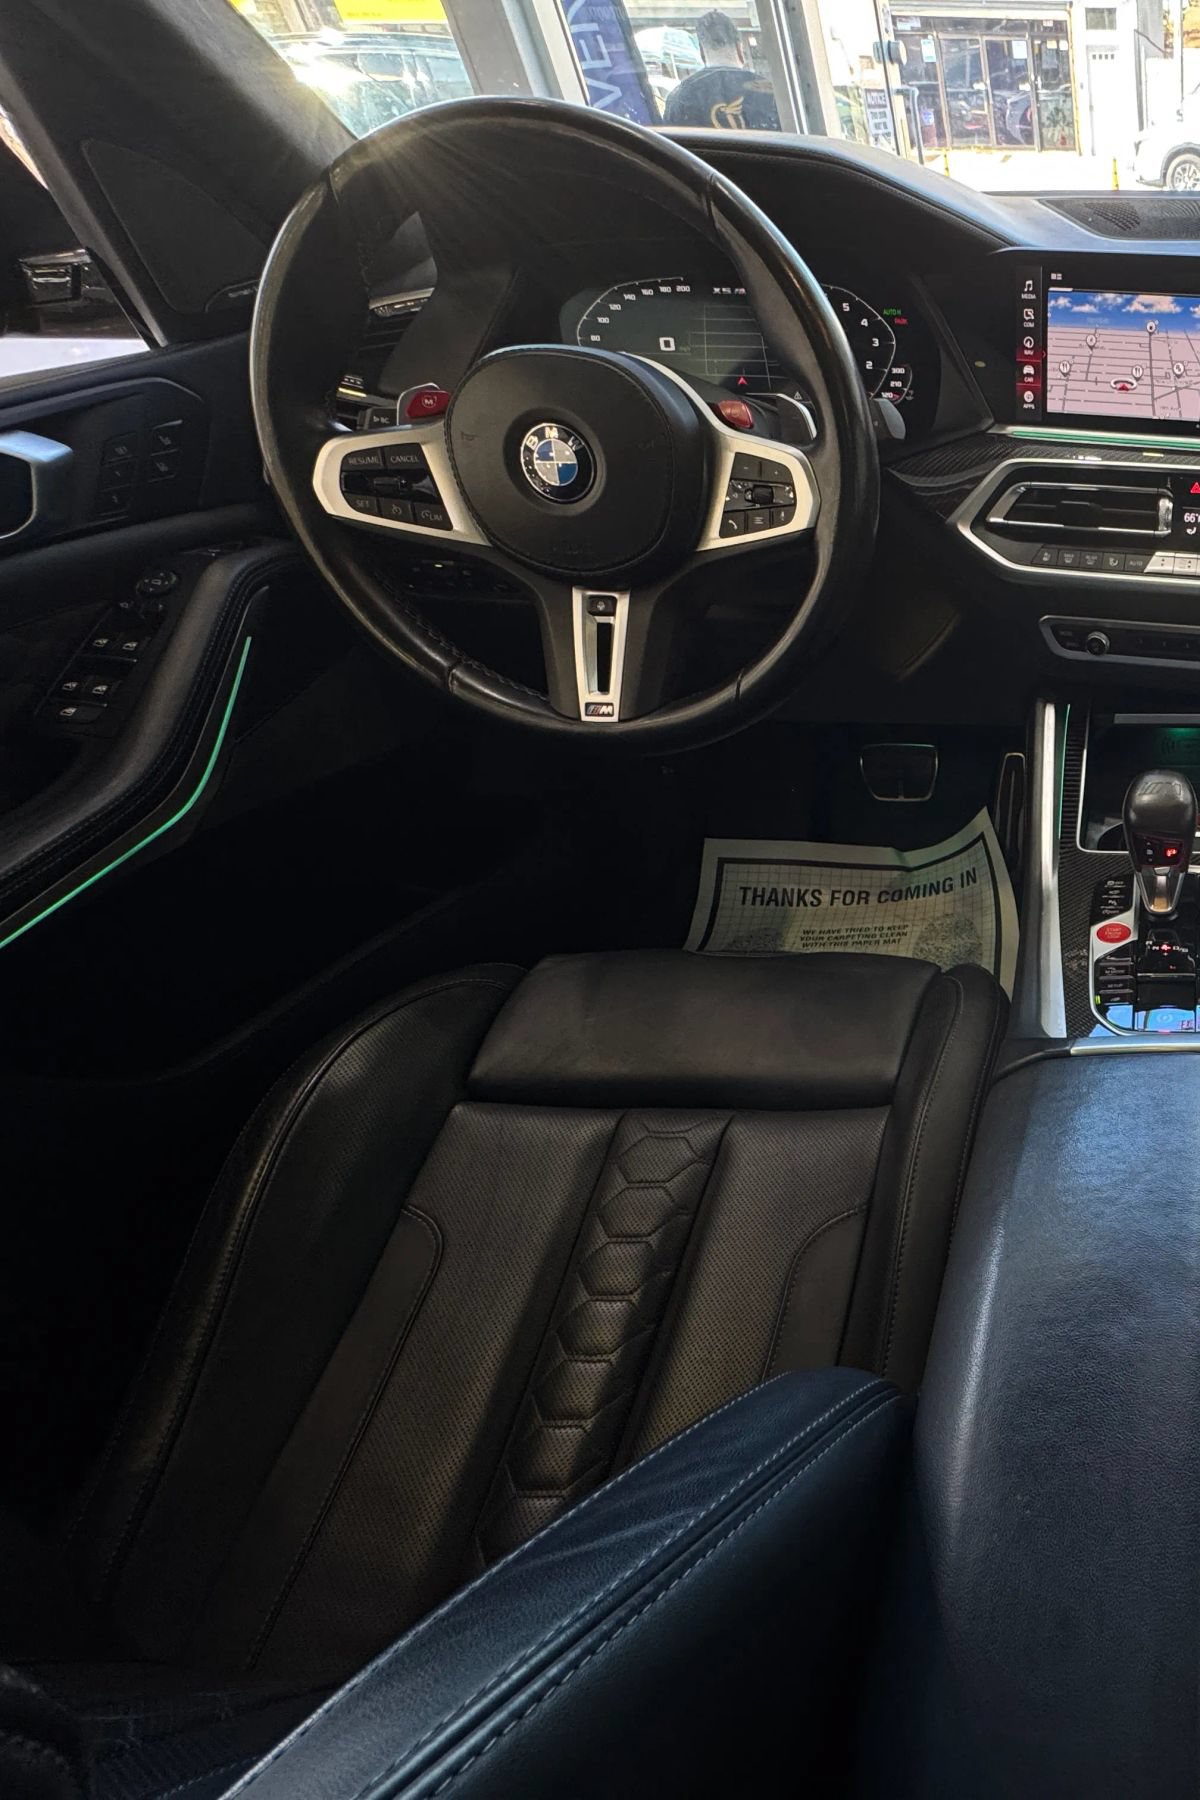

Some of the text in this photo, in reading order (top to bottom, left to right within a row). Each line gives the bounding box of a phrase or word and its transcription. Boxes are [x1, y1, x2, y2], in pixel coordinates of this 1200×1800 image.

[676, 285, 691, 293] 200
[842, 303, 851, 312] 5
[860, 318, 869, 327] 4
[659, 337, 676, 351] 0
[872, 338, 880, 347] 3
[865, 361, 873, 369] 2
[525, 426, 584, 452] BMW
[348, 455, 419, 465] RESUME CANCEL
[740, 867, 977, 908] THANKS FOR COMING IN
[880, 931, 908, 939] CLEAN
